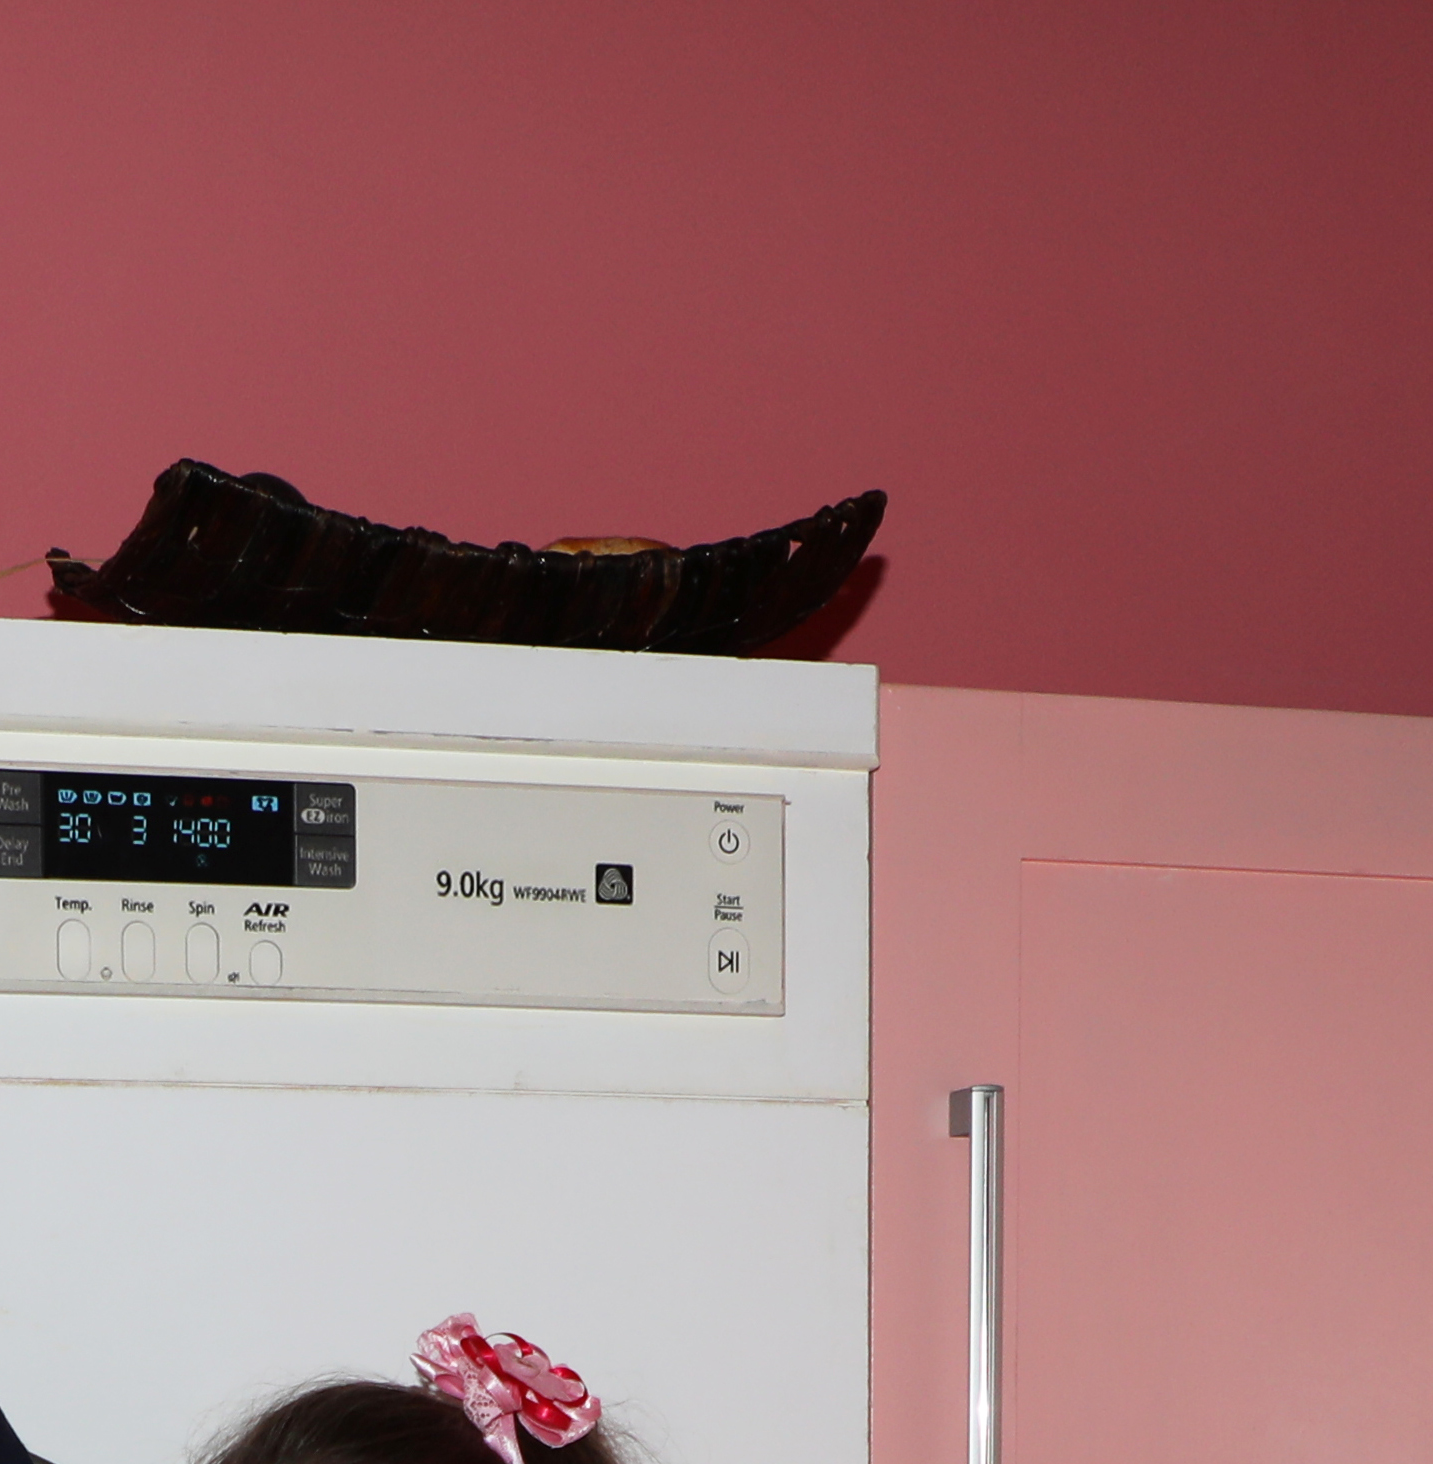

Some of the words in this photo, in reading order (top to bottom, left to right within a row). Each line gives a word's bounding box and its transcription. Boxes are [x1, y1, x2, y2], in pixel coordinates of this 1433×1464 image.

[1, 782, 22, 796] Pre
[308, 793, 343, 810] Super
[714, 801, 744, 814] Power
[59, 813, 91, 843] 30
[133, 815, 147, 845] 3
[173, 818, 230, 848] 1400
[1, 852, 23, 866] End
[300, 847, 349, 862] Intensive
[309, 863, 342, 876] Wash
[436, 870, 504, 906] 9.0kg
[55, 897, 92, 912] Temp.
[122, 898, 154, 914] Rinse
[716, 893, 740, 906] Start
[189, 901, 215, 917] Spin
[243, 902, 290, 917] AIR
[714, 909, 743, 921] Pause
[244, 919, 286, 933] Refresh
